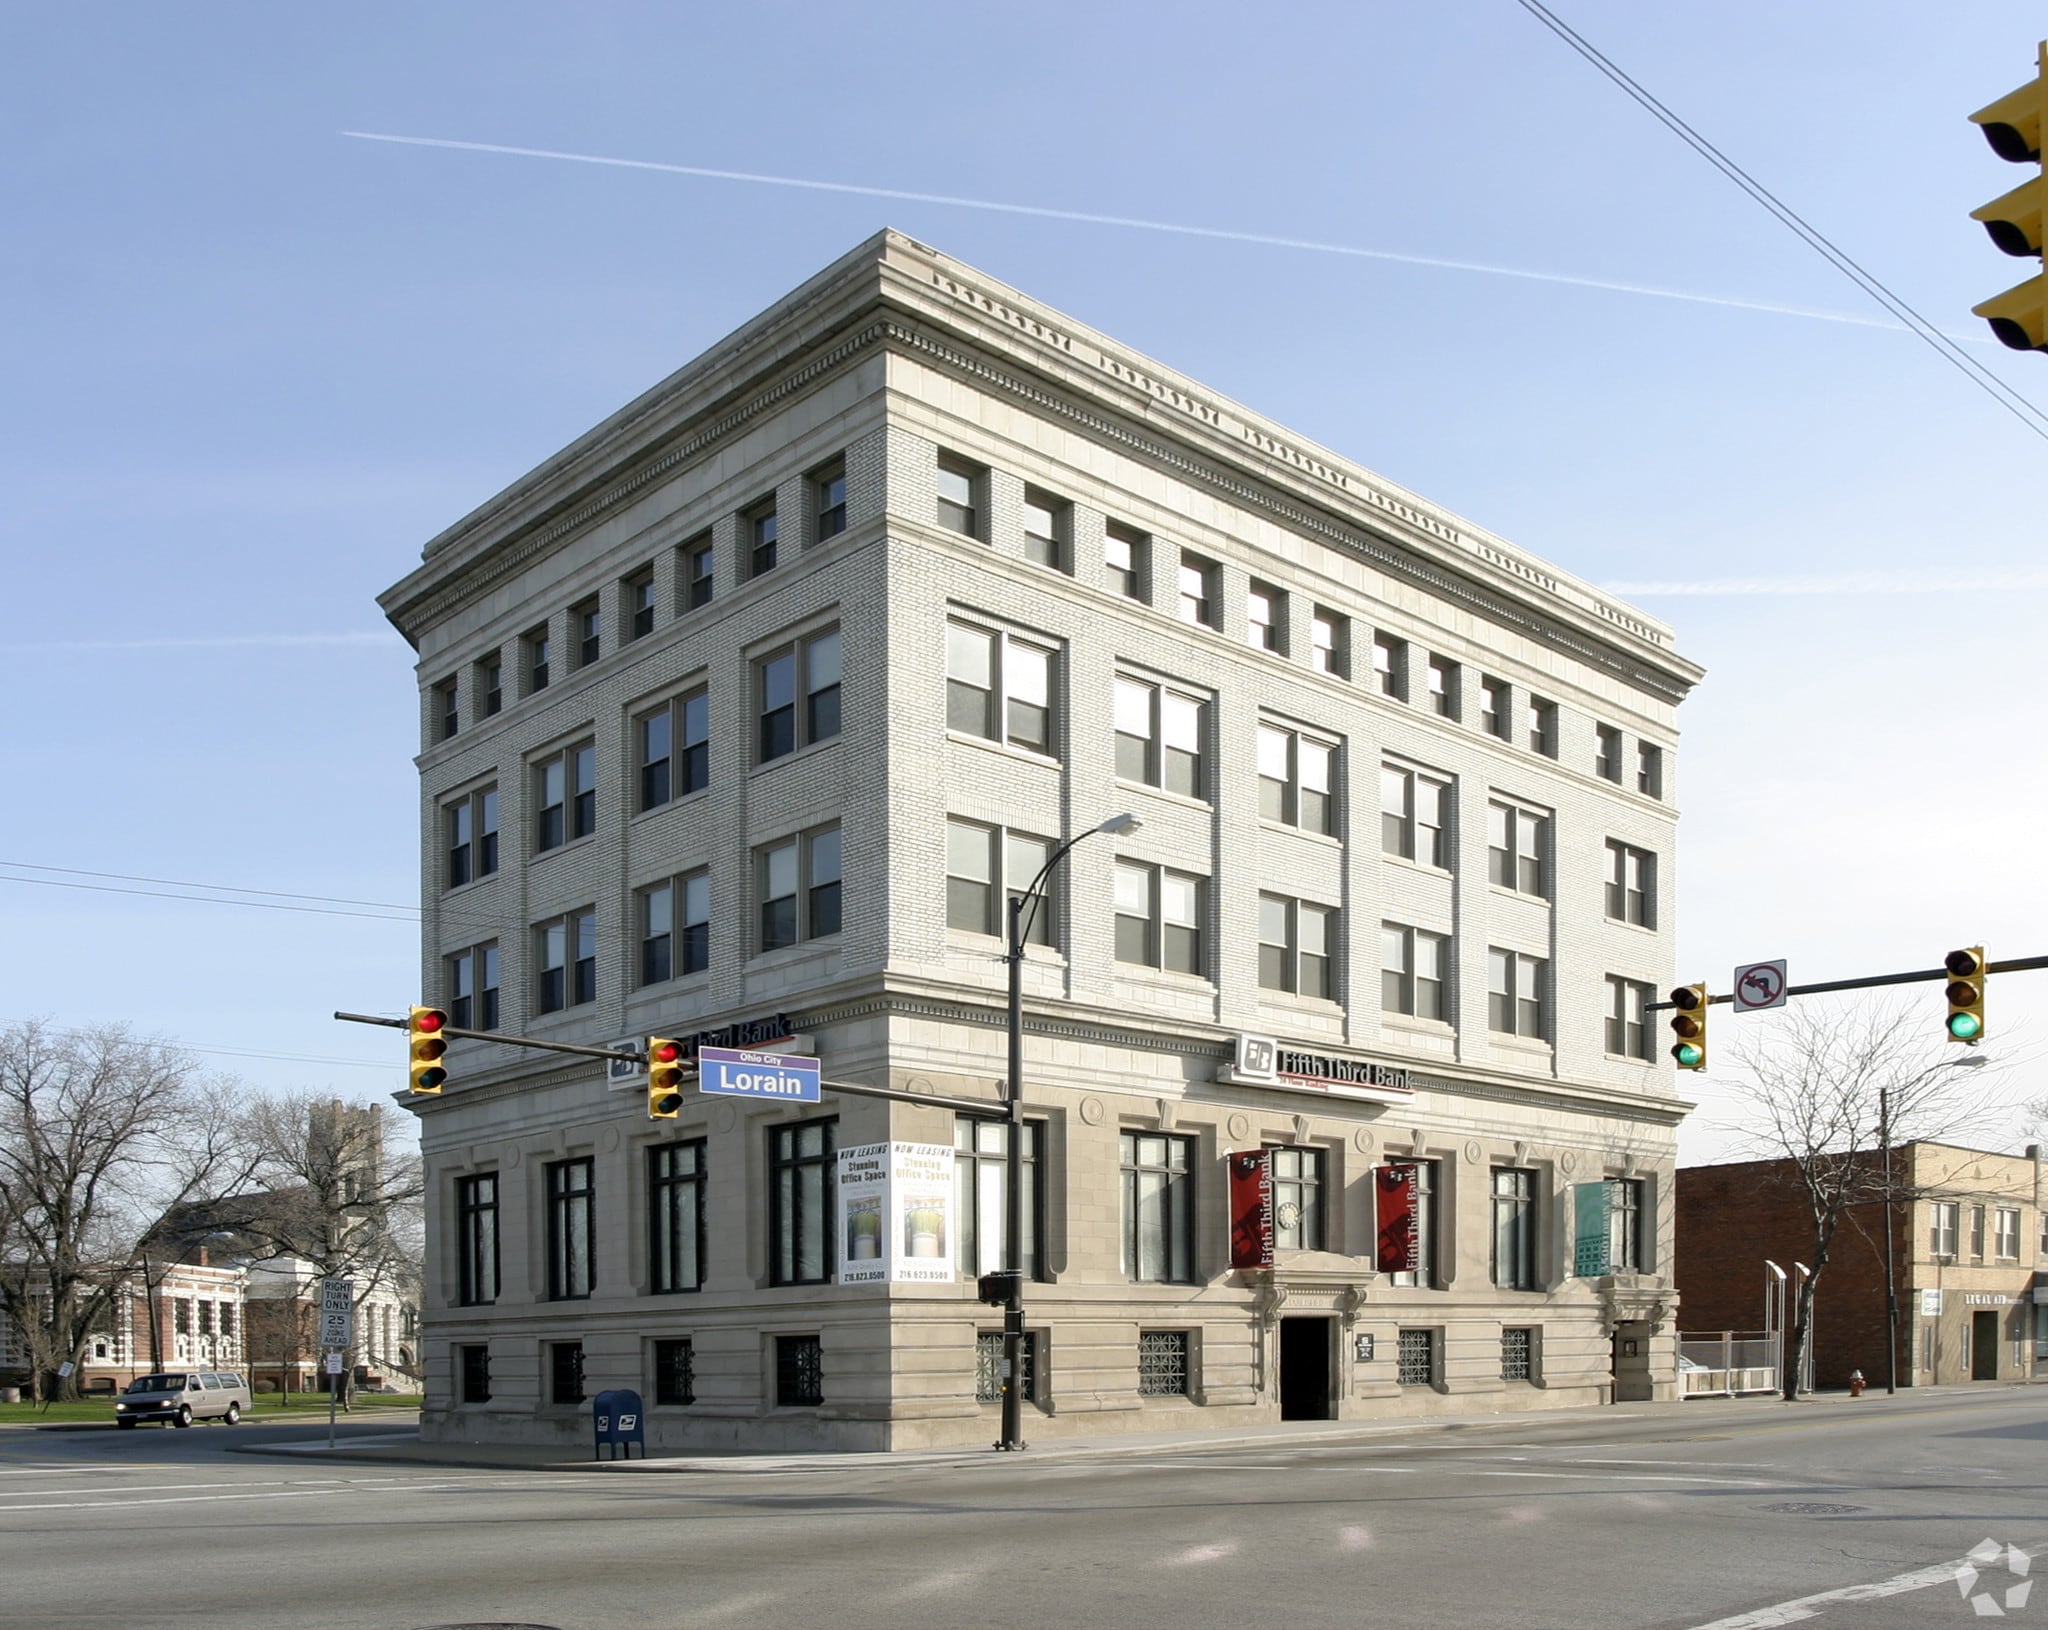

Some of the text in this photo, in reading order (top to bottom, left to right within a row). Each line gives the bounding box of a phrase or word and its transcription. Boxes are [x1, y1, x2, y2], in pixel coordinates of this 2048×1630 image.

[738, 1013, 790, 1047] Bank
[740, 1053, 783, 1066] Ohio City
[1282, 1051, 1413, 1090] Fifth Third Bank
[720, 1066, 802, 1095] Lorain
[840, 1145, 887, 1159] NOW LEASING
[895, 1144, 952, 1157] NOW LEASING
[848, 1160, 879, 1171] Stunning
[904, 1158, 941, 1170] Stunning
[841, 1171, 886, 1184] Office Space
[896, 1168, 950, 1181] Office Space
[1258, 1153, 1273, 1264] Fifth Third Bank
[1404, 1168, 1419, 1269] Fifth Third Bank
[325, 1281, 351, 1292] RIGHT
[326, 1291, 349, 1300] TURN
[325, 1300, 349, 1310] ONLY
[328, 1315, 345, 1325] 25
